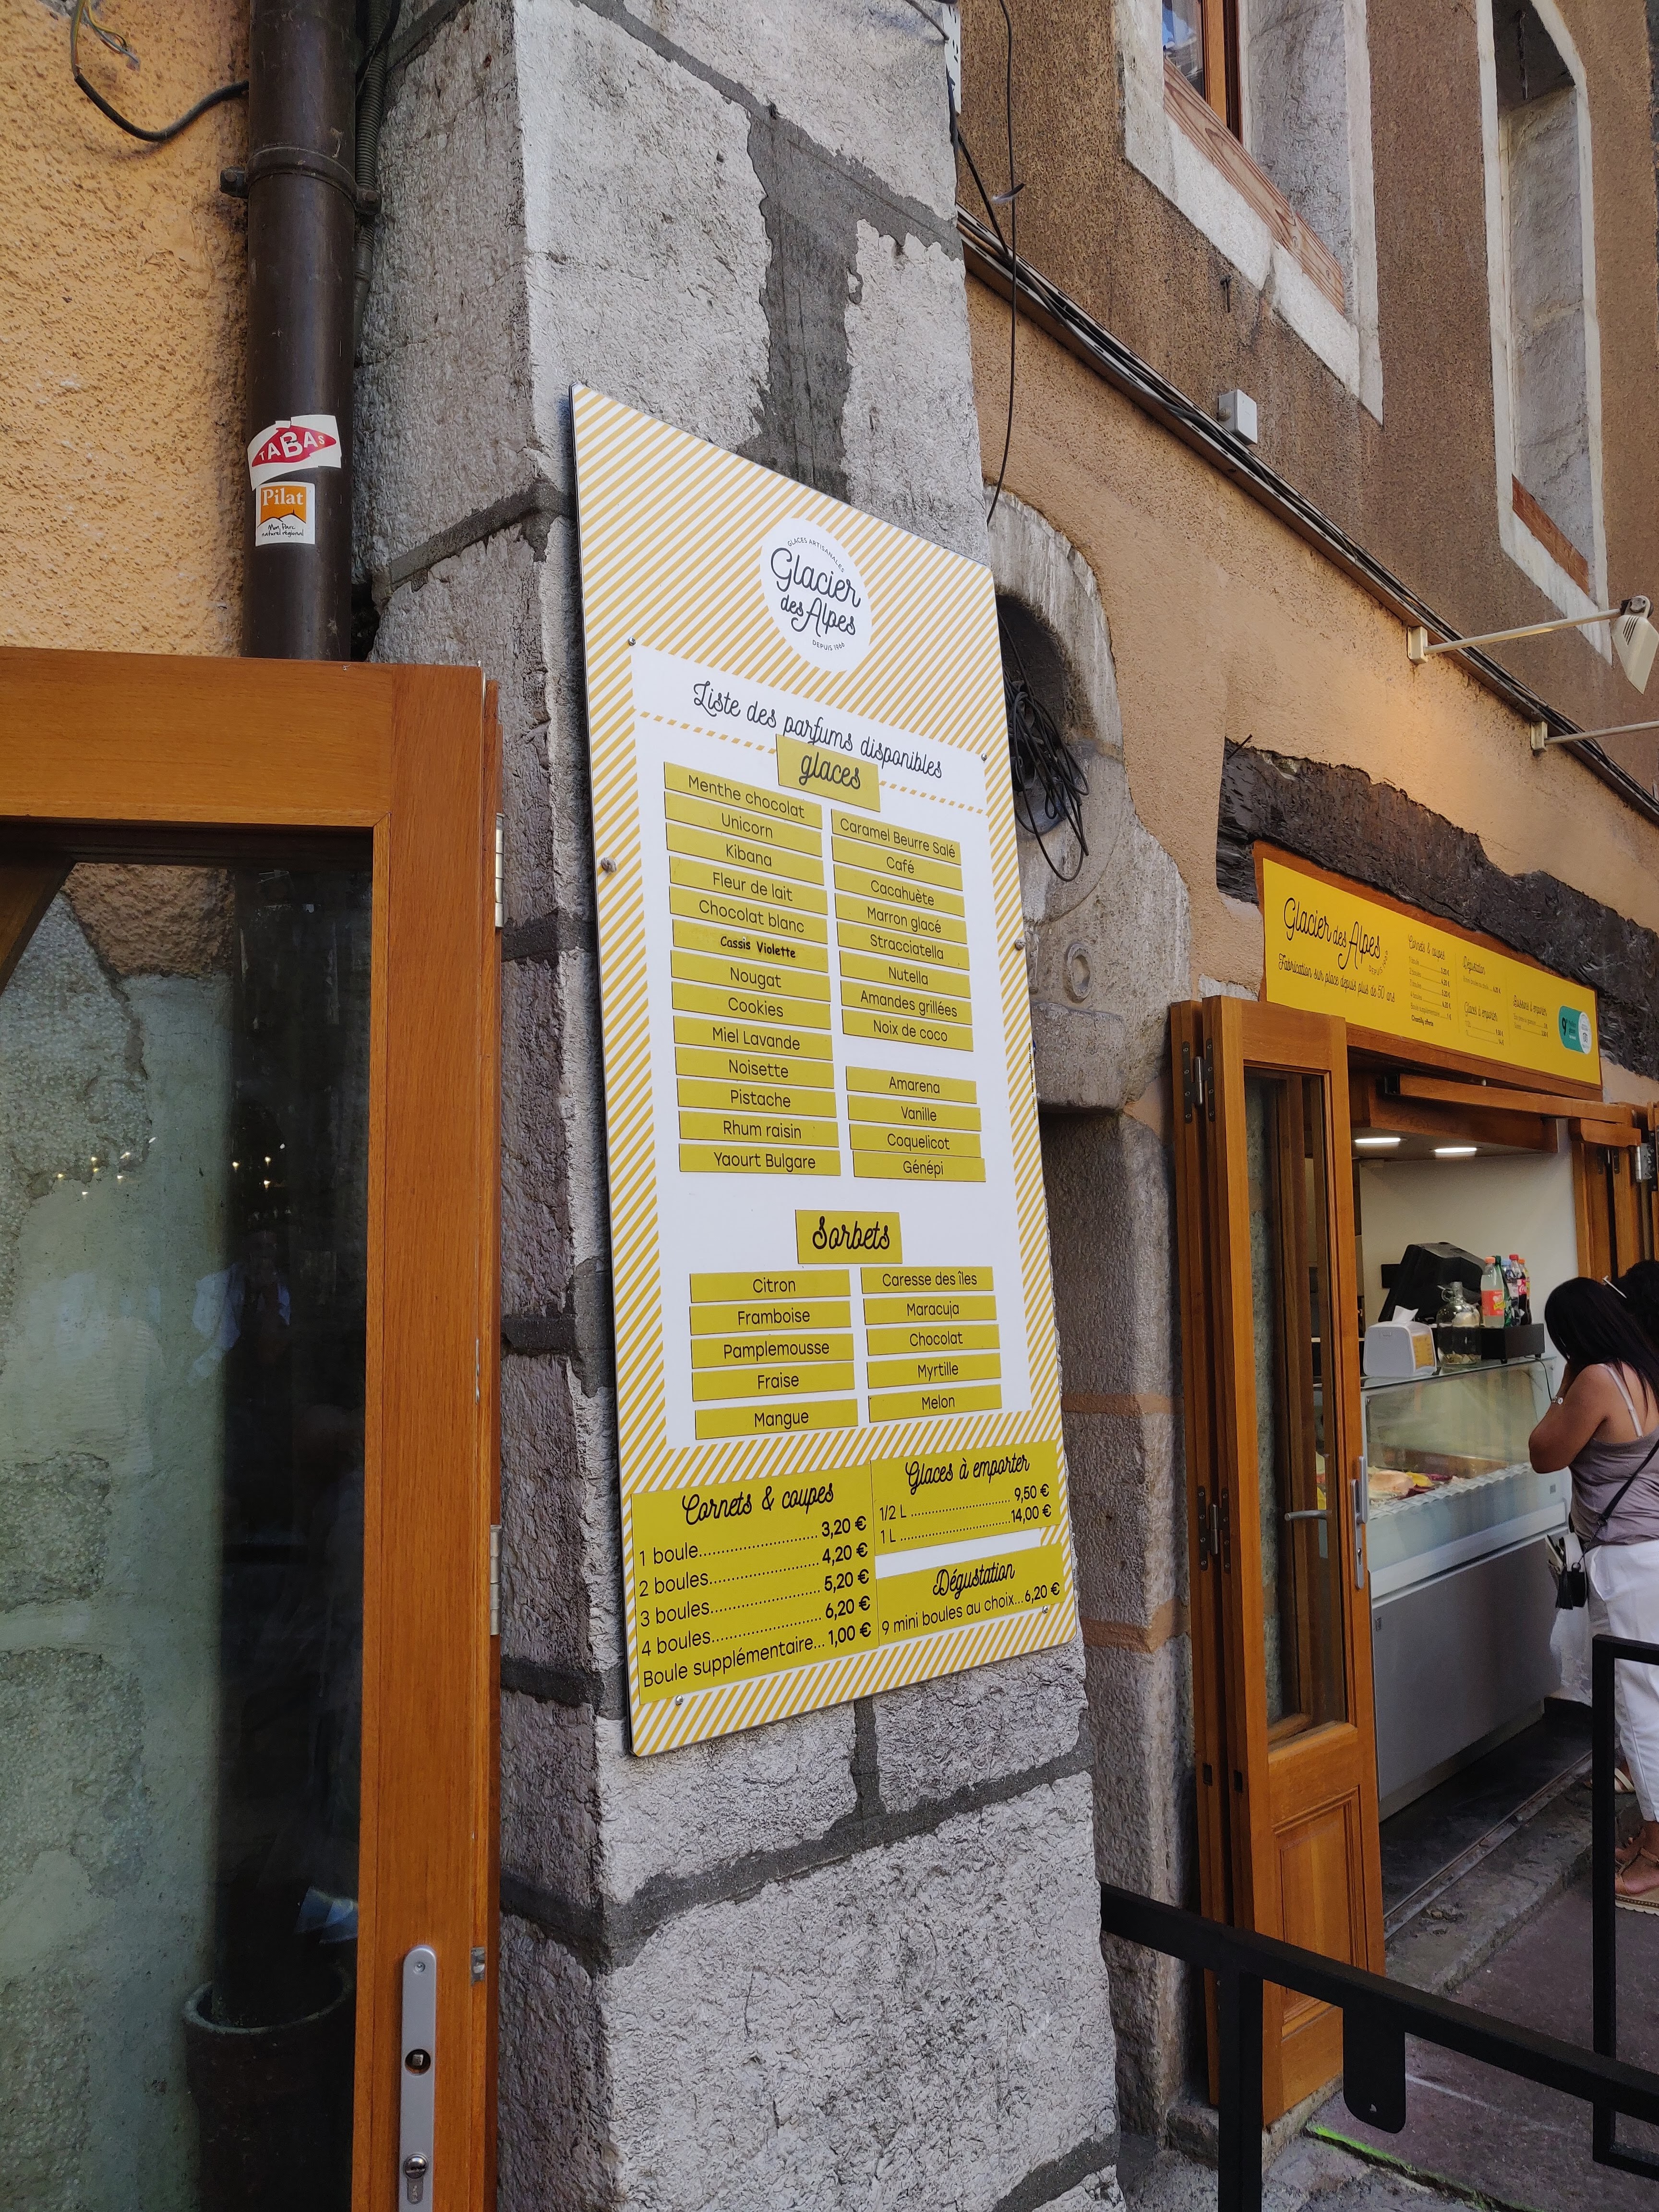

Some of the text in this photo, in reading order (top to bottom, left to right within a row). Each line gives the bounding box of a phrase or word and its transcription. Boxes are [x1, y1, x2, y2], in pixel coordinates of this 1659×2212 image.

[259, 432, 325, 461] TABAS
[262, 488, 304, 506] Pilat
[787, 537, 845, 573] GLACES ARTISANALES
[770, 547, 861, 608] Glacier
[781, 594, 856, 637] des Alpes
[812, 639, 845, 651] DEPUIS 1966
[694, 681, 941, 778] Liste des parfums disponibles
[799, 752, 860, 790] glaces
[689, 775, 805, 818] Menthe chocolat
[722, 813, 772, 839] Unicorn
[841, 818, 955, 858] Caramel Beurre Salé
[726, 843, 771, 867] Kibana
[887, 857, 914, 874] Café
[713, 872, 793, 902] Fleur de lait
[871, 880, 934, 906] Cacahuète
[699, 900, 804, 933] Chocolat blanc
[867, 906, 941, 933] Marron glacé
[1284, 897, 1380, 970] Glacier des Alpes
[721, 936, 795, 958] Cassis Violette
[870, 934, 943, 960] Stracciatella
[731, 967, 781, 989] Nougat
[889, 966, 928, 986] Nutella
[1278, 953, 1395, 1003] Fabrication sur place depuis plus de 50 ans
[1369, 964, 1383, 976] DEPUIS
[729, 998, 783, 1017] Cookies
[861, 990, 957, 1017] Amandes grillées
[713, 1027, 800, 1050] Miel Lavande
[874, 1019, 947, 1042] Noix de coco
[729, 1059, 788, 1078] Noisette
[889, 1076, 940, 1094] Amarena
[731, 1089, 791, 1107] Pistache
[901, 1106, 937, 1121] Vanille
[723, 1120, 801, 1139] Rhum raisin
[888, 1133, 950, 1151] Coquelicot
[714, 1152, 816, 1172] Yaourt Bulgare
[903, 1159, 943, 1178] Génépi
[812, 1216, 890, 1250] Sorbets
[753, 1277, 795, 1293] Citron
[883, 1271, 977, 1287] Caresse des îles
[738, 1307, 810, 1325] Framboise
[907, 1301, 959, 1319] Maracuja
[724, 1341, 829, 1361] Pamplemousse
[910, 1331, 963, 1346] Chocolat
[758, 1372, 799, 1389] Fraise
[918, 1361, 958, 1382] Myrtille
[922, 1394, 955, 1410] Melon
[755, 1412, 808, 1430] Mangue
[905, 1453, 1030, 1495] Glaces à emporter
[682, 1483, 833, 1525] Cornets & coupes
[879, 1484, 1049, 1521] 1/2 L 9,50 €
[881, 1504, 1051, 1544] 1 L 14,00 €
[640, 1551, 645, 1566] 1
[822, 1518, 850, 1539] 3,20
[855, 1515, 866, 1531] €
[639, 1580, 649, 1597] 2
[822, 1545, 852, 1566] 4,20
[856, 1542, 868, 1557] €
[933, 1562, 1015, 1600] Dégustation
[640, 1611, 649, 1627] 3
[825, 1572, 853, 1593] 5,20
[857, 1569, 869, 1584] €
[882, 1621, 889, 1635] 9
[894, 1612, 918, 1633] mini
[966, 1602, 980, 1615] au
[1025, 1585, 1047, 1604] 6,20
[1051, 1582, 1060, 1596] €
[642, 1641, 651, 1656] 4
[826, 1599, 854, 1621] 6,20
[859, 1596, 870, 1611] €
[644, 1663, 687, 1687] Boule
[829, 1625, 855, 1647] 1,00
[860, 1622, 871, 1637] €
